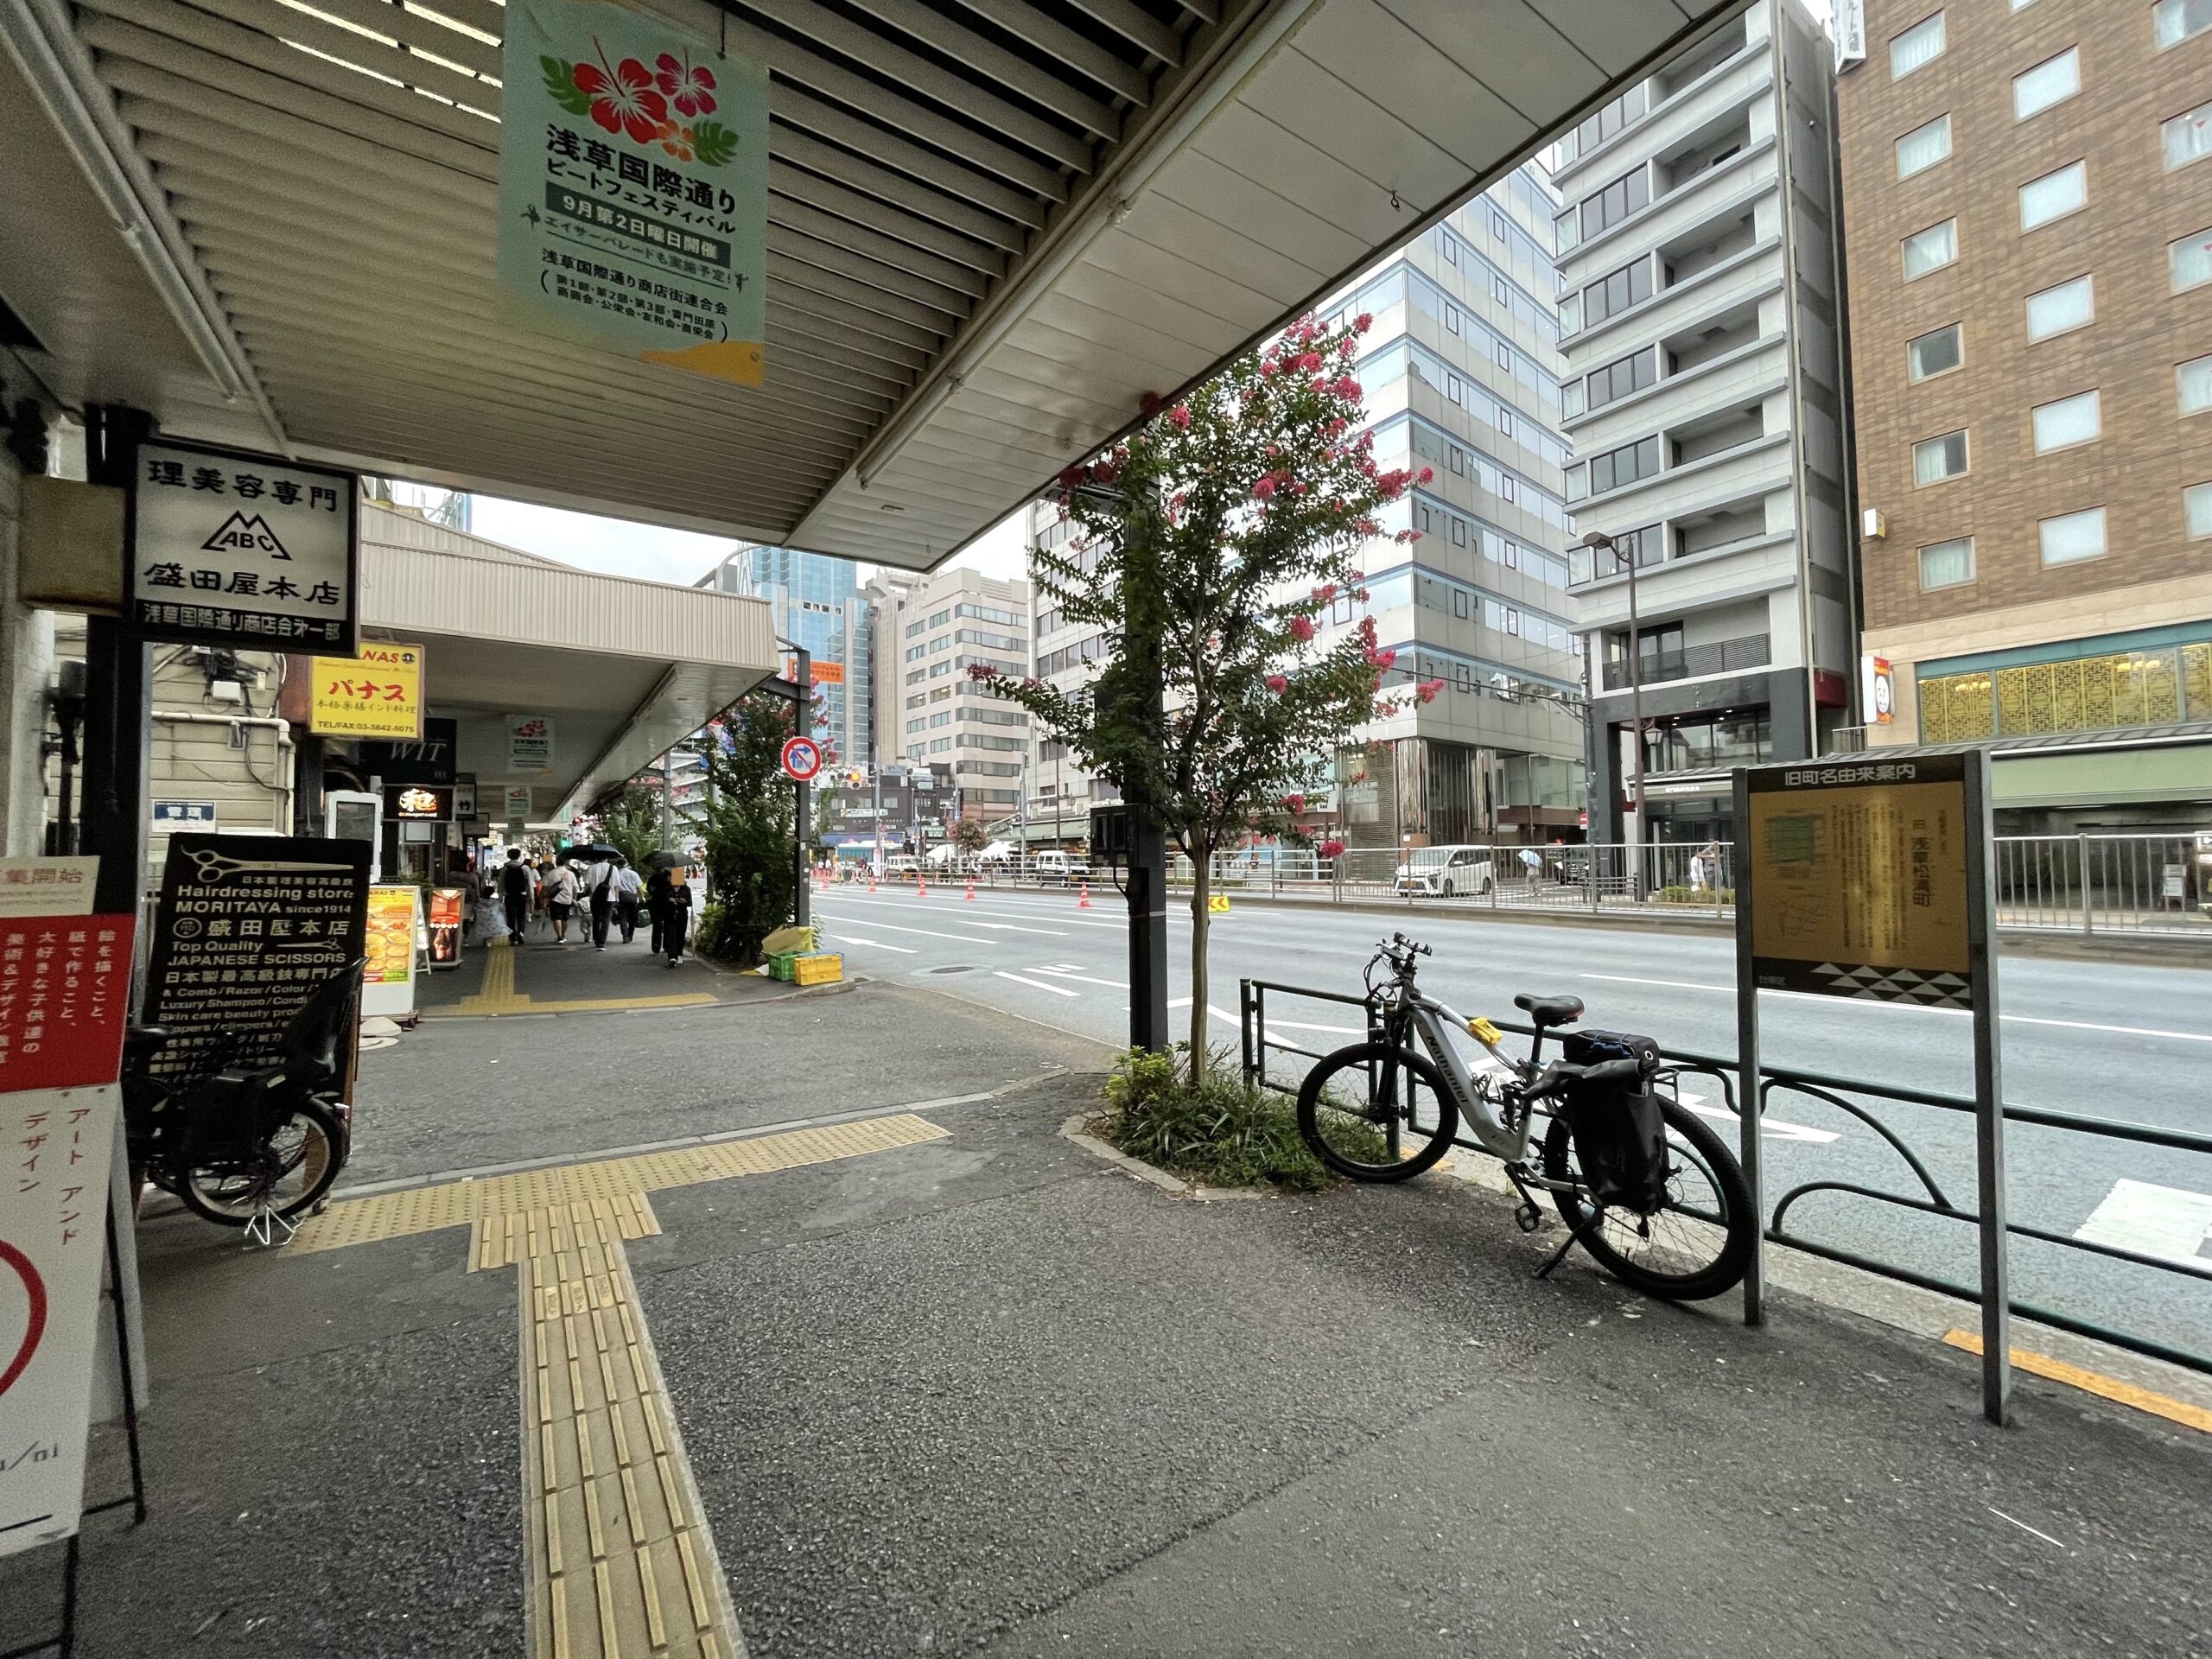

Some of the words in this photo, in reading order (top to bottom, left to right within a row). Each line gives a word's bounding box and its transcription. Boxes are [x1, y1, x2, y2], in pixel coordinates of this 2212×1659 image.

[547, 124, 735, 214] 浅草国際通り
[547, 158, 736, 234] ビートフェスティバル
[563, 195, 718, 259] 9月第2日曜日開催
[542, 248, 728, 315] 浅草国際通り商店街連合会
[148, 460, 337, 512] 理美容専門
[219, 531, 275, 552] ABC
[143, 562, 340, 605] 盛田屋本店
[363, 650, 399, 663] NAS
[328, 679, 405, 702] パナス
[391, 742, 447, 761] WIT
[1784, 763, 1916, 786] 旧町名由来案内
[0, 868, 83, 885] 集開始
[177, 885, 302, 900] Hairdressing
[306, 887, 354, 899] store
[175, 901, 281, 913] MORITAYA
[286, 905, 352, 913] since1914
[207, 919, 350, 936] 盛田屋本店
[173, 941, 201, 954] Top
[205, 940, 264, 953] Quality
[168, 955, 258, 966] JAPANESE
[264, 952, 346, 964] SCISSORS
[89, 930, 118, 1025] 絵を描くこと、
[192, 1012, 222, 1020] care
[68, 1109, 92, 1165] アート
[19, 1111, 50, 1192] デザイン
[60, 1186, 84, 1245] アンド
